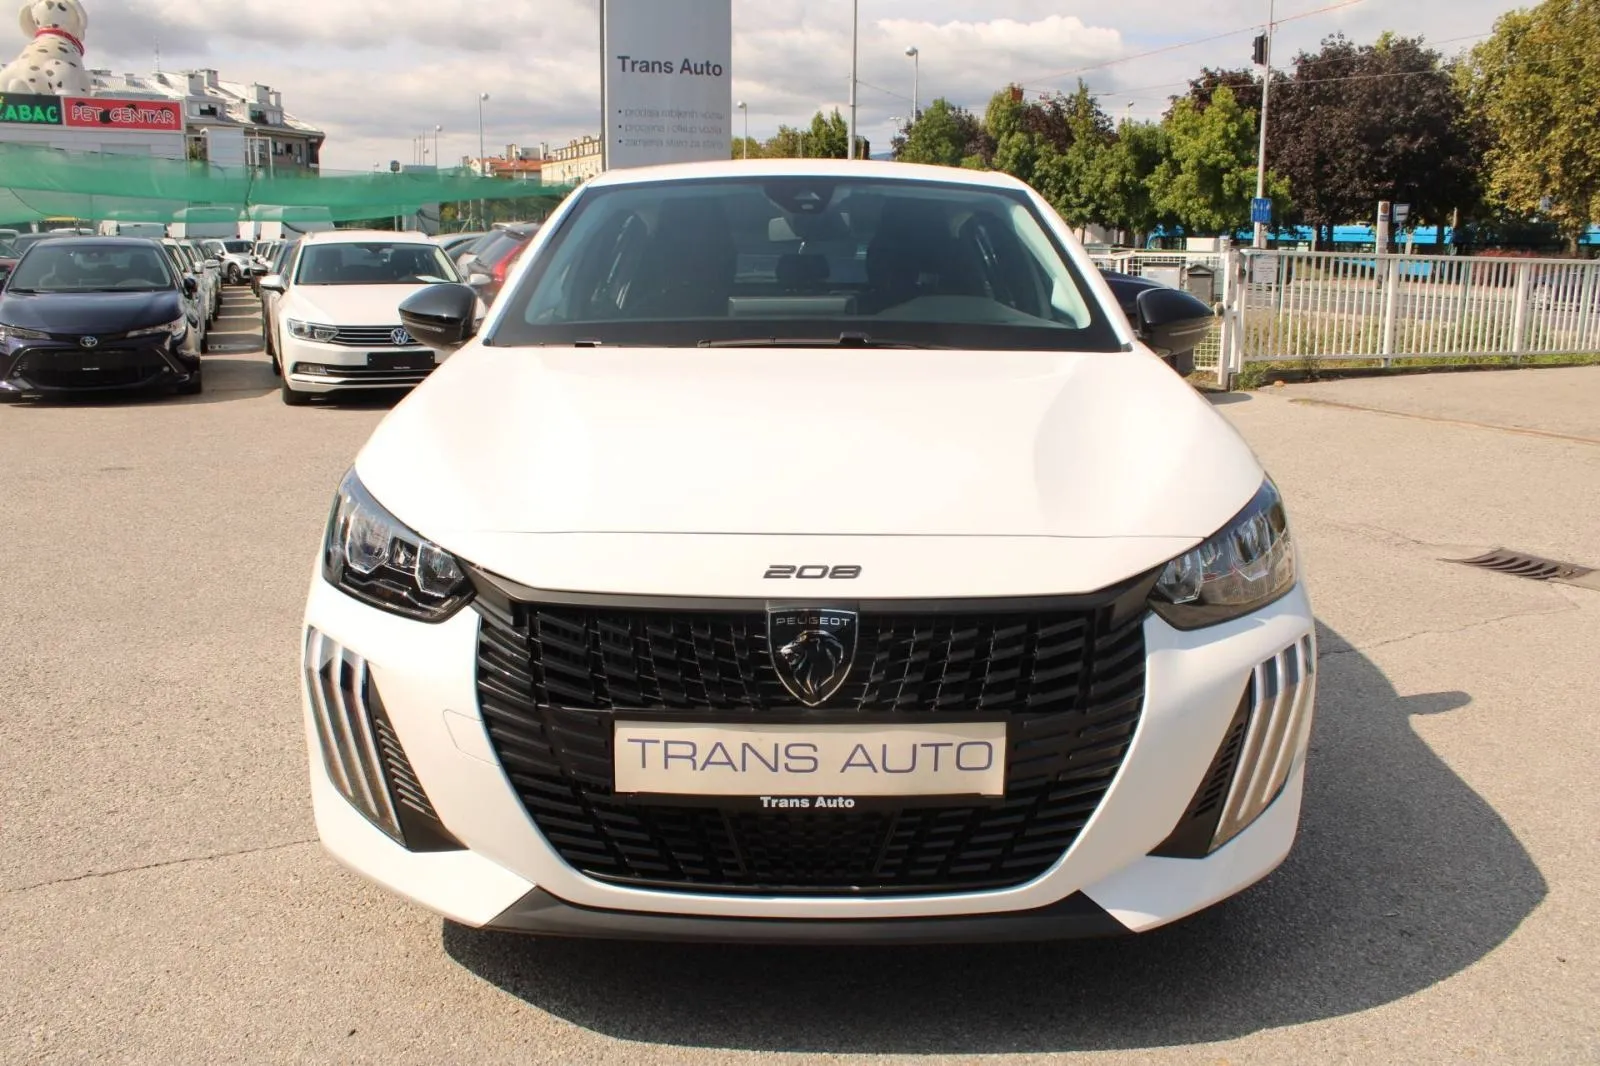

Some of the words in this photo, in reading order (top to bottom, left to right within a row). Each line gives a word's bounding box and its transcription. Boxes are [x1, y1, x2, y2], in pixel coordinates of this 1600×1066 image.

[617, 55, 674, 74] Trans
[680, 58, 723, 77] Auto
[71, 105, 103, 121] PET
[109, 107, 175, 124] CENTAR
[763, 564, 862, 579] 208
[776, 616, 850, 627] PEUGEOT
[627, 737, 819, 773] TRANS
[840, 740, 993, 775] AUTO
[760, 796, 810, 809] Trans
[814, 796, 856, 809] Auto
